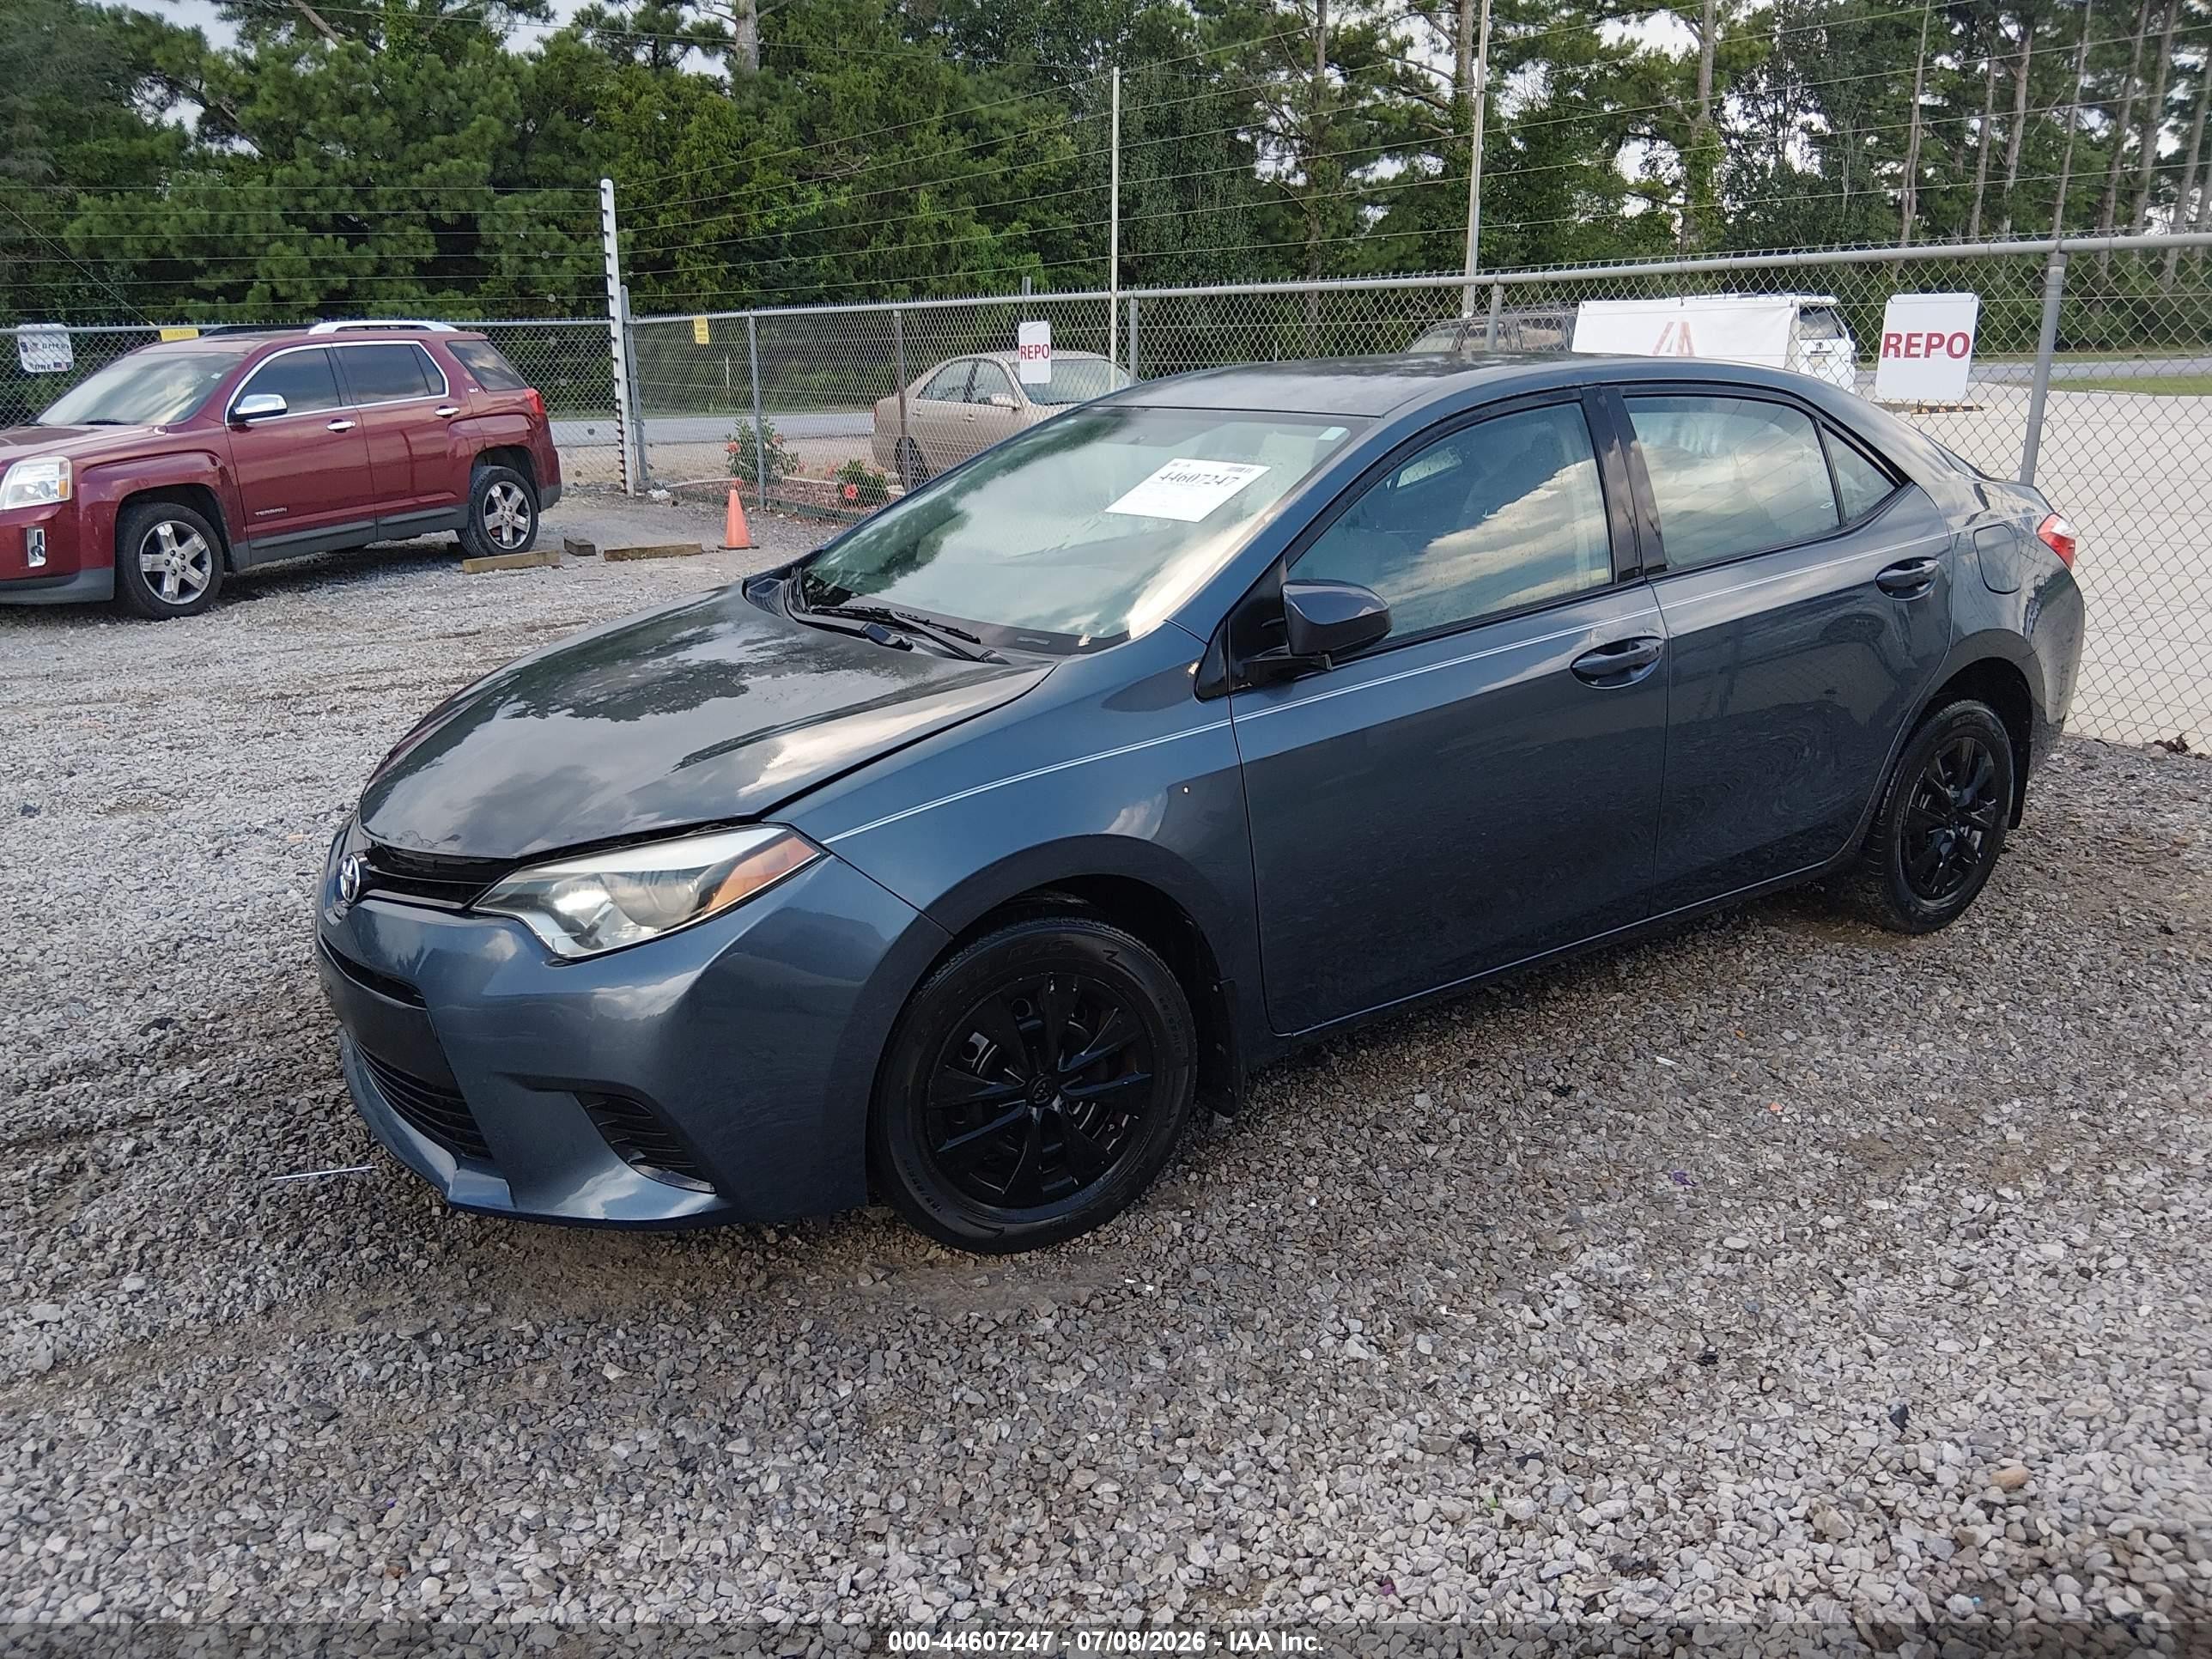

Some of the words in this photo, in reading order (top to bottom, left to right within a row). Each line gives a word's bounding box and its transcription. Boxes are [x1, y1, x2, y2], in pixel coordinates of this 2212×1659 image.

[1020, 344, 1049, 360] REPO
[1882, 331, 1970, 359] REPO
[1159, 471, 1241, 487] 44607247
